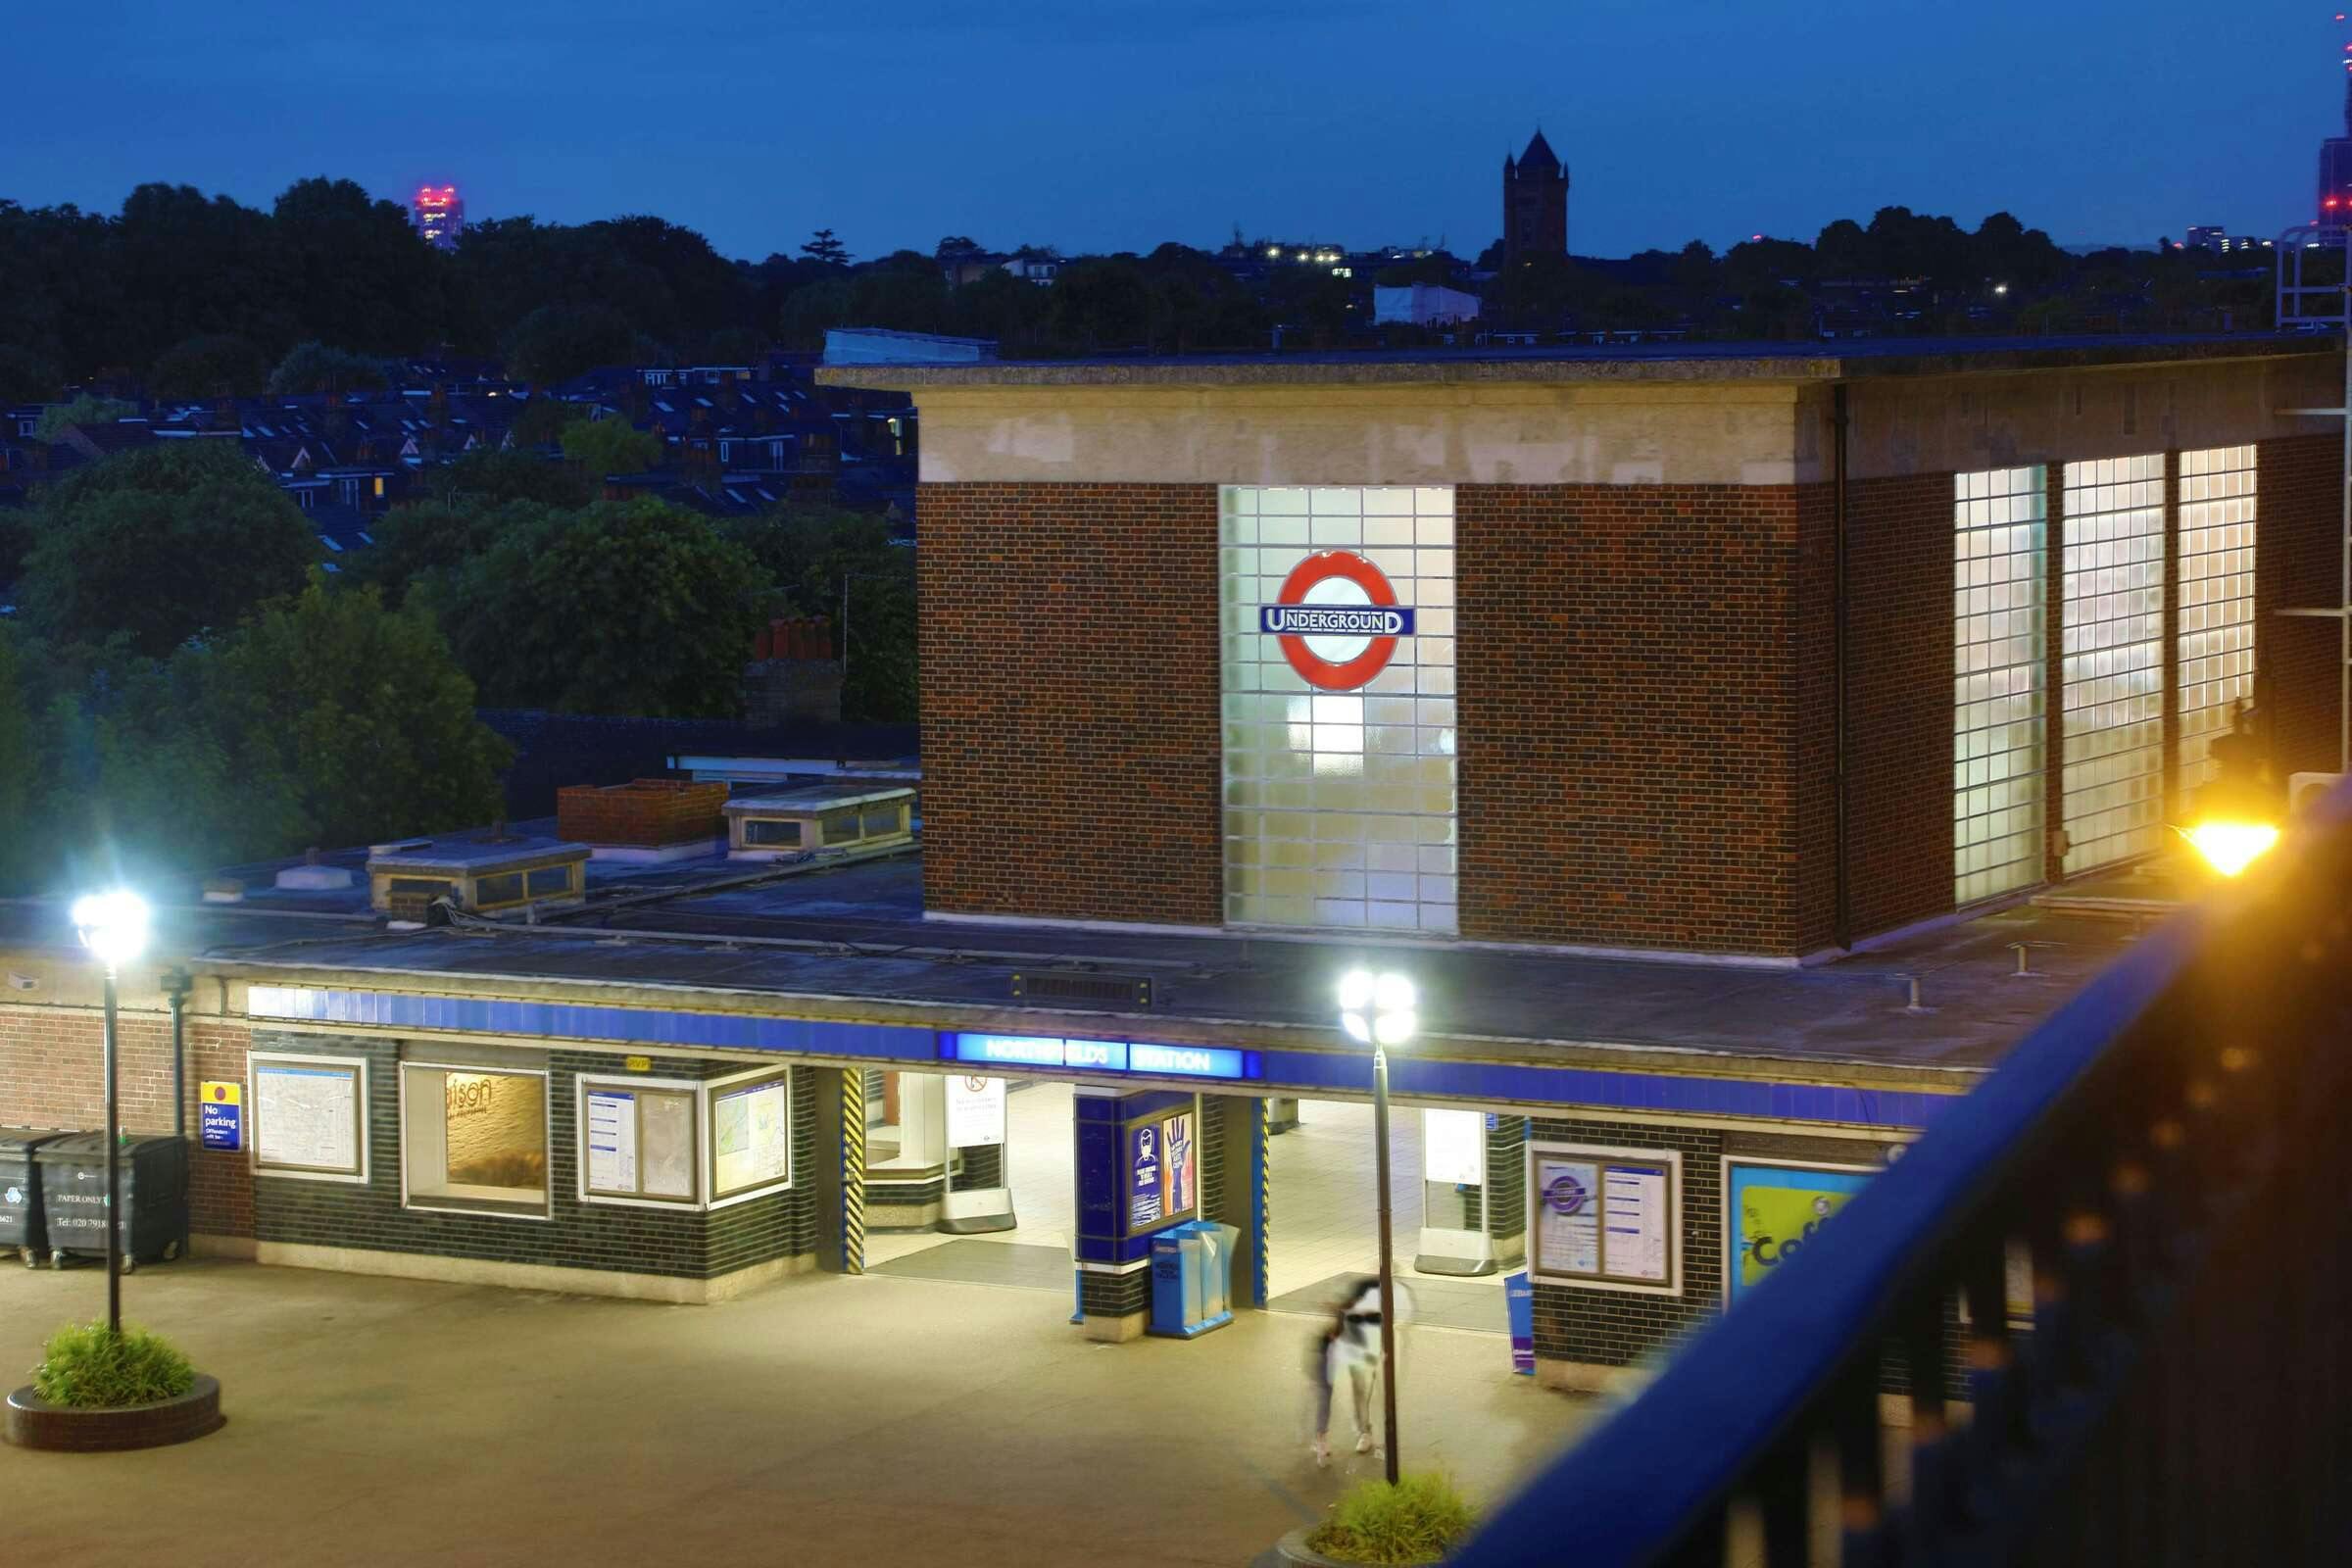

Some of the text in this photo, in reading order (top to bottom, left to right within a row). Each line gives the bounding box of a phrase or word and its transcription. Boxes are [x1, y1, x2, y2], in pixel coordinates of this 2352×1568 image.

[1266, 609, 1403, 633] UNDERGROUND
[986, 1039, 1210, 1071] NORTHFIELDS STATION
[205, 1104, 218, 1115] No
[205, 1117, 236, 1129] parking
[57, 1195, 101, 1204] PAPER ONLY
